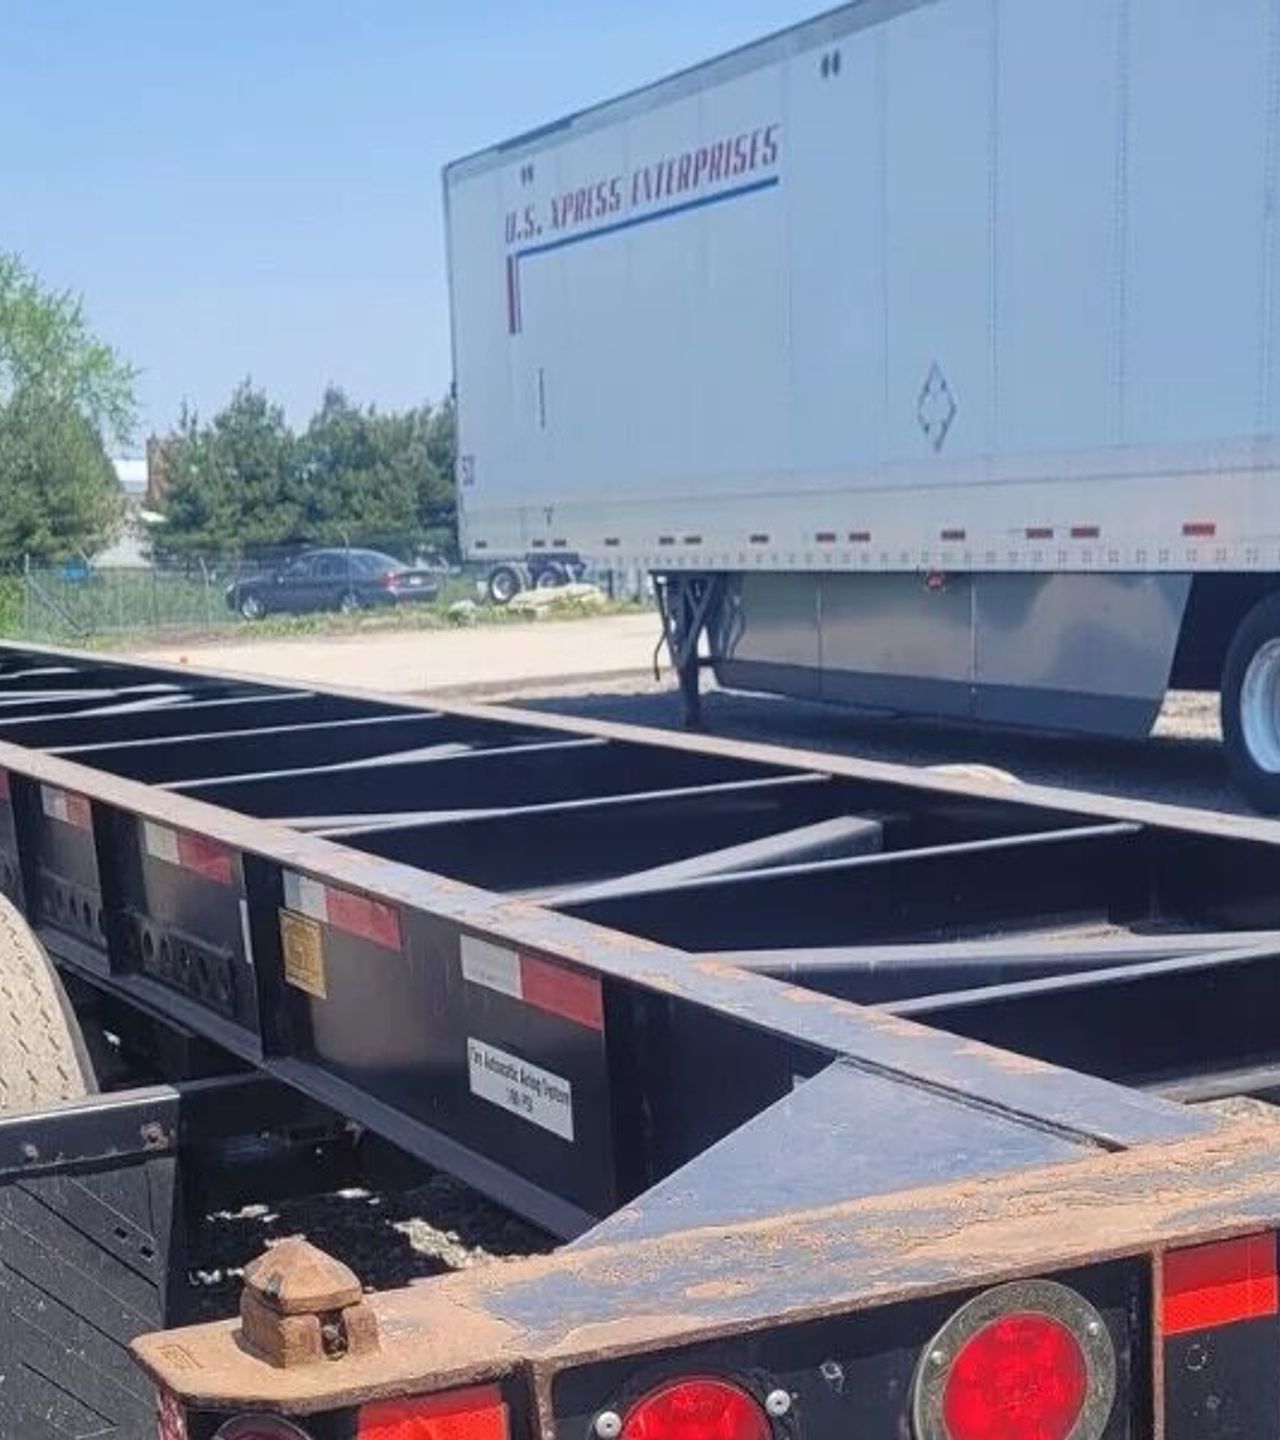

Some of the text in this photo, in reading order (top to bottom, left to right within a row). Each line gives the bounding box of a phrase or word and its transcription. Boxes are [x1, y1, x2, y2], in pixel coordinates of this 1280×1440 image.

[505, 124, 780, 244] U.S. XPRESS ENTERPRISES
